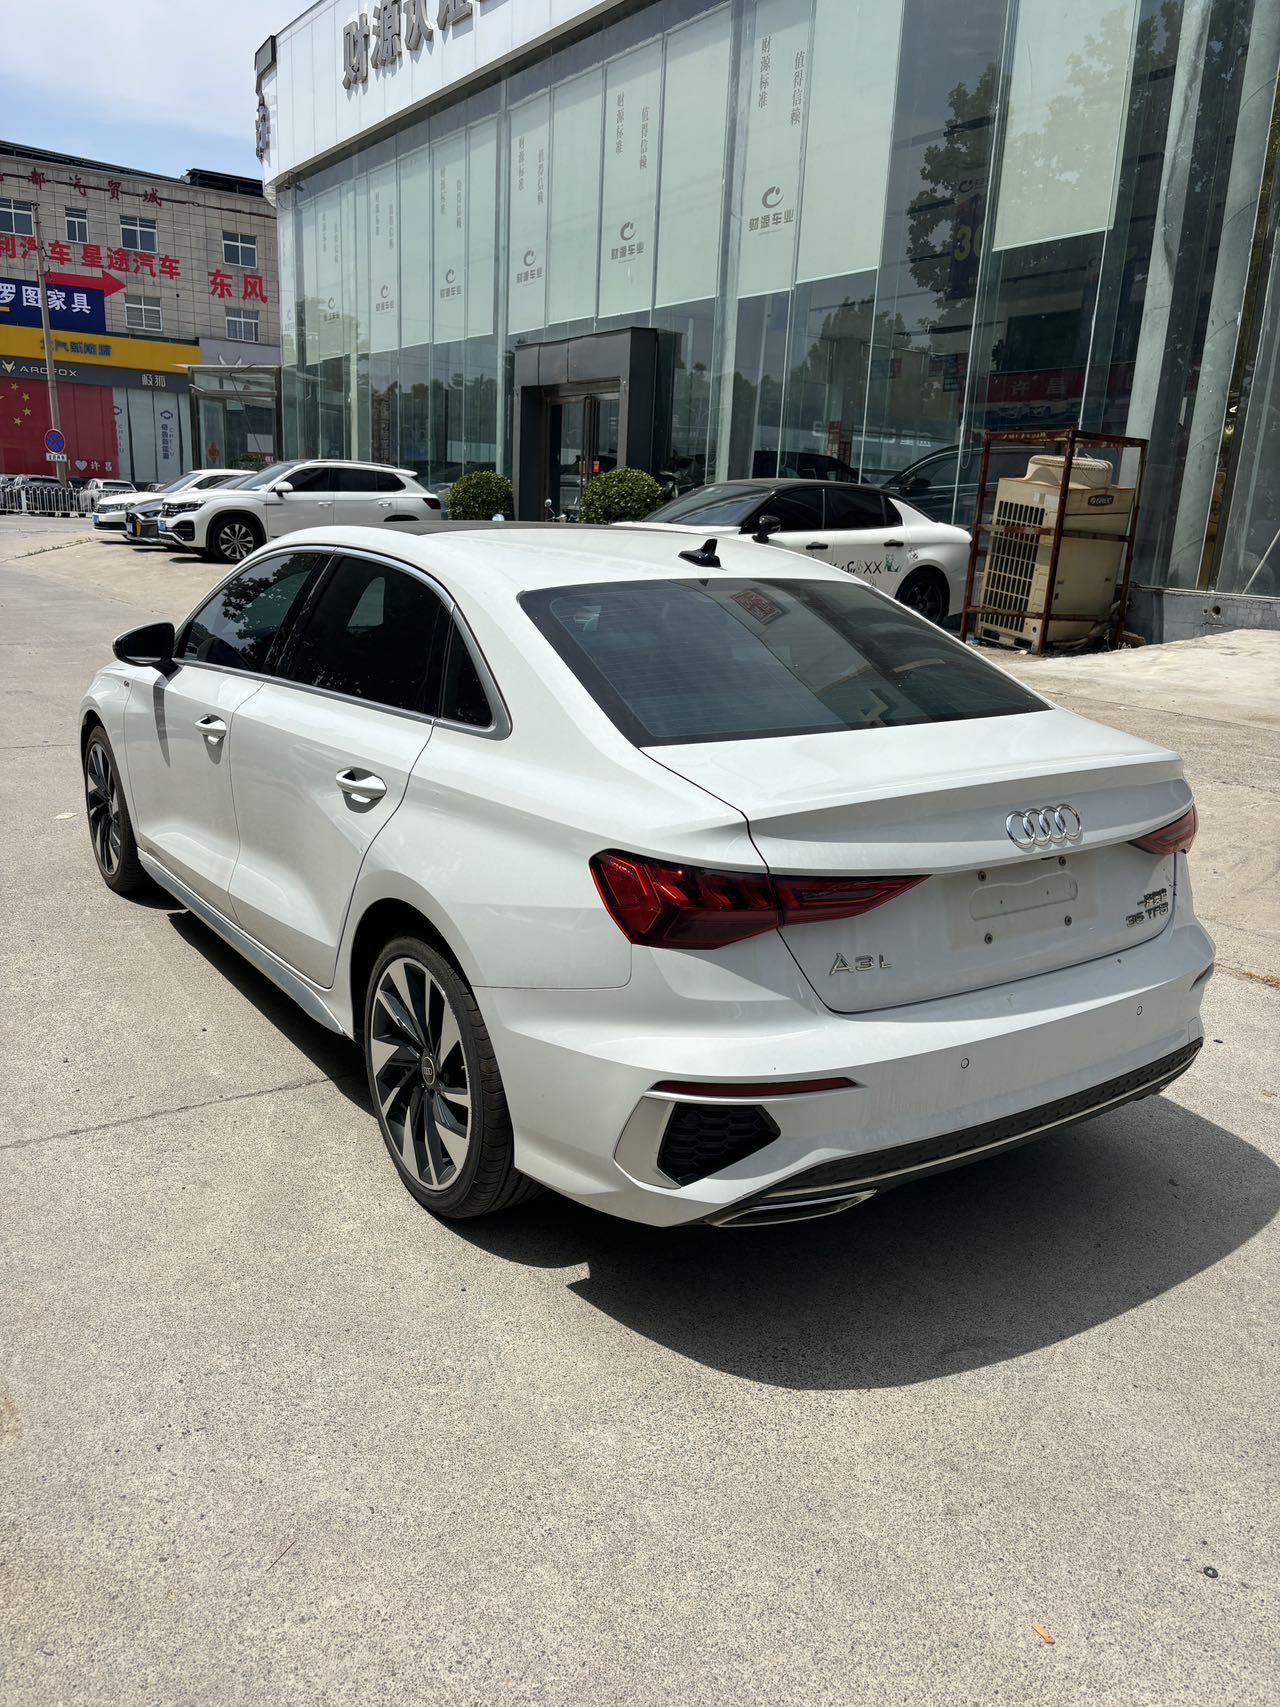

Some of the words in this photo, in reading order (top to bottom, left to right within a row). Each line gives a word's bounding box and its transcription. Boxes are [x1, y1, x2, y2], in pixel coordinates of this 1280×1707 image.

[0, 167, 162, 207] 都汽贸城
[748, 208, 795, 232] 财源车业
[208, 268, 269, 304] 东风
[1125, 911, 1145, 928] 35
[828, 952, 893, 977] A3L
